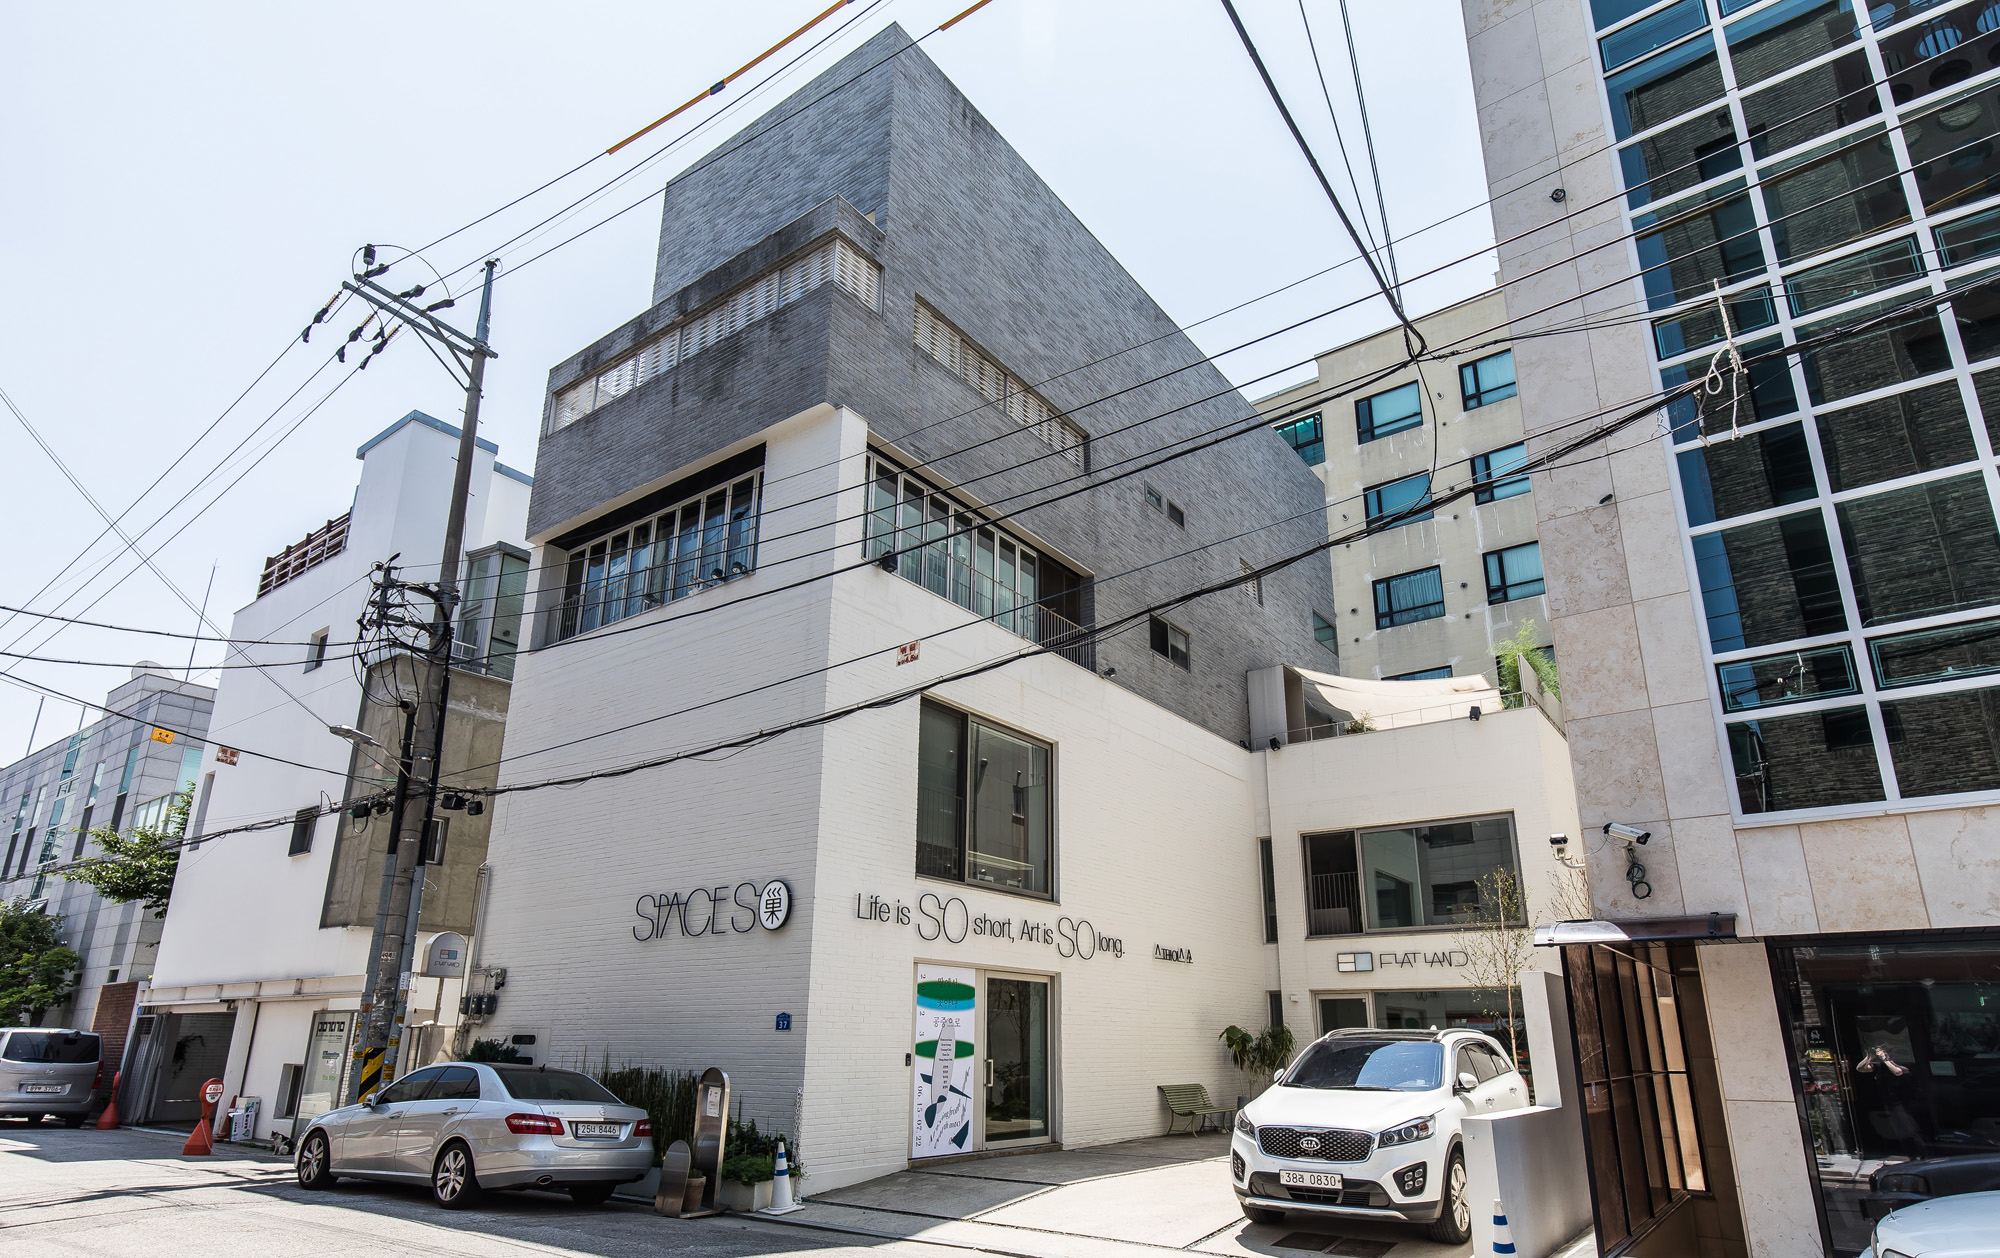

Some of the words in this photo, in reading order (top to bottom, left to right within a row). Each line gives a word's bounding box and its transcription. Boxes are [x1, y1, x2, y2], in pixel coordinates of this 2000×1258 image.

[633, 886, 729, 942] SPACE
[857, 892, 891, 923] Life
[896, 899, 911, 926] is
[917, 893, 969, 944] SO
[973, 912, 1015, 944] short,
[1020, 919, 1041, 943] Art
[1043, 923, 1054, 945] is
[1057, 916, 1096, 960] SO
[1098, 931, 1126, 959] long.
[778, 1020, 788, 1029] 37
[598, 1125, 617, 1134] 8446
[1302, 1140, 1317, 1148] KIA
[1309, 1174, 1336, 1187] 0830
